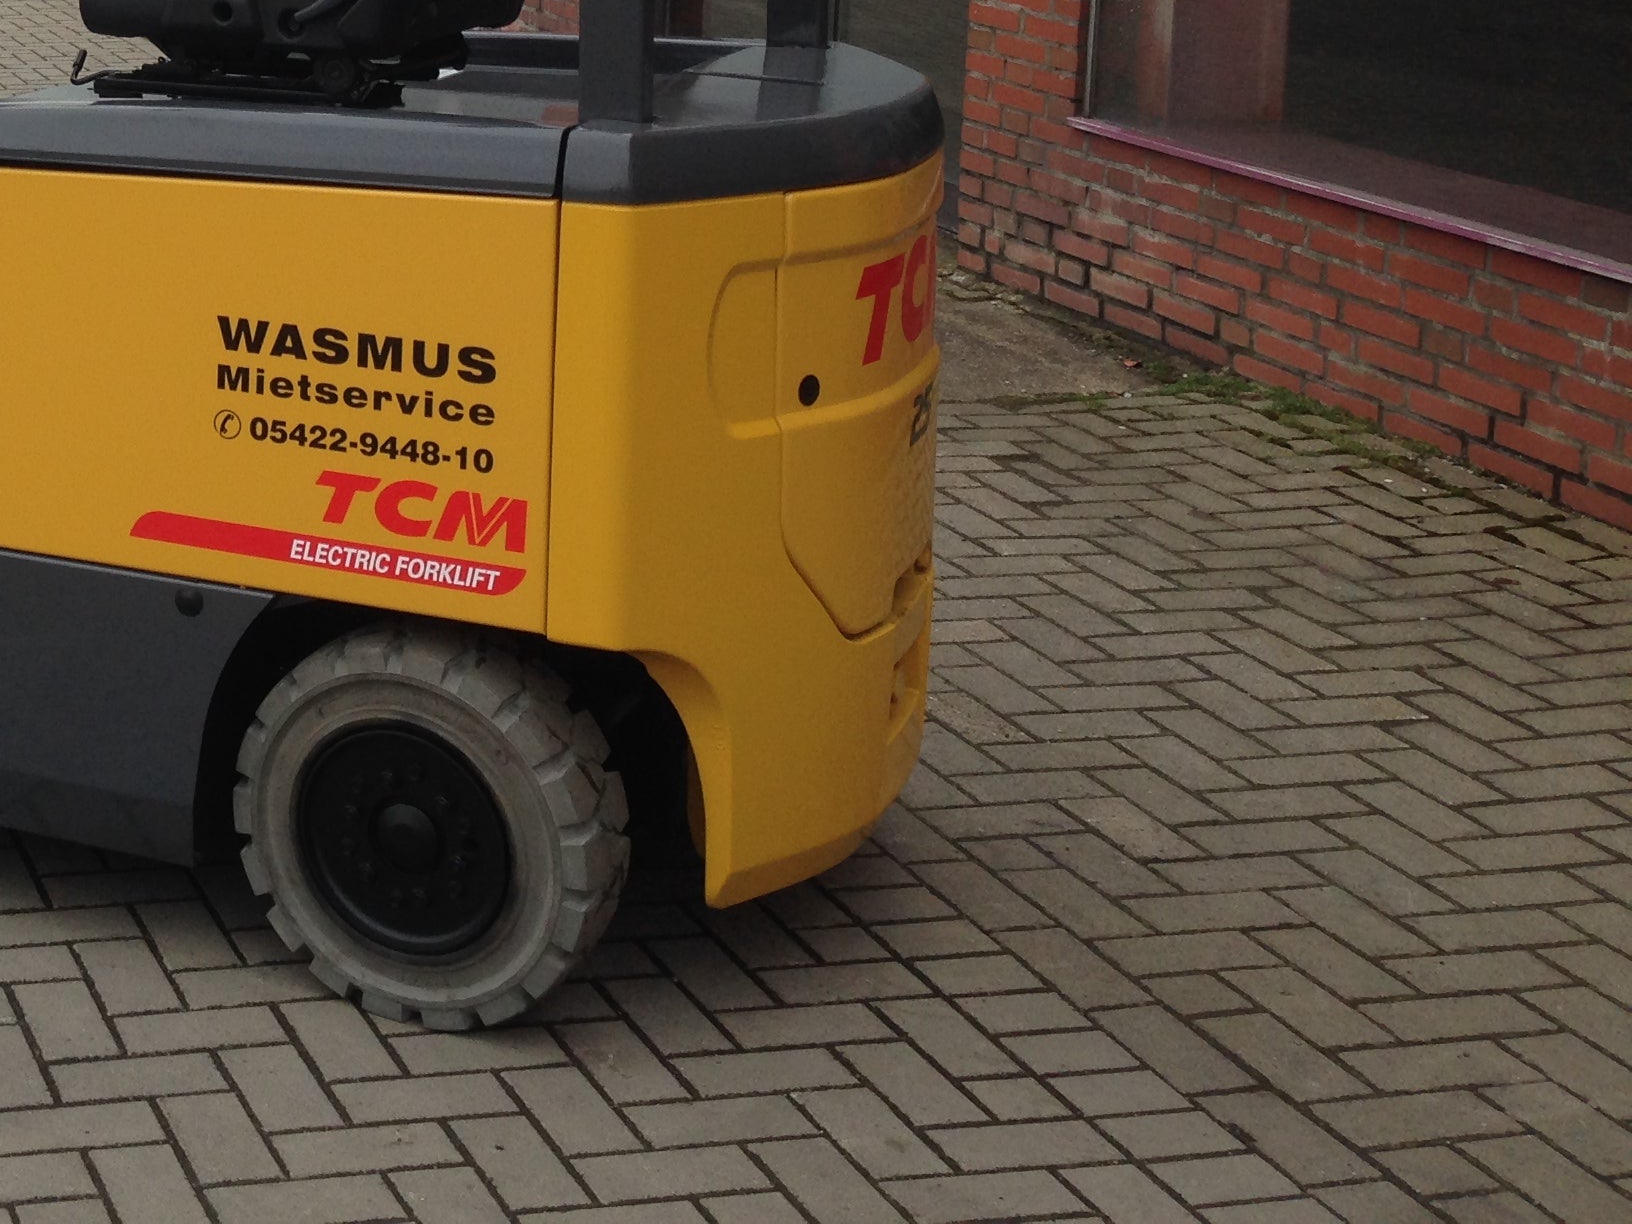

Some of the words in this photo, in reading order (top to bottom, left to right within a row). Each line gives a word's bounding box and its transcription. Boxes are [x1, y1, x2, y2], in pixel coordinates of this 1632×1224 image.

[855, 226, 937, 367] TC
[217, 315, 497, 384] WASMUS
[217, 364, 495, 426] Mietservice
[249, 417, 494, 474] 05422-9448-10
[315, 470, 528, 554] TCM
[289, 539, 392, 574] ELECTRIC
[394, 556, 501, 591] FORKLIFT
